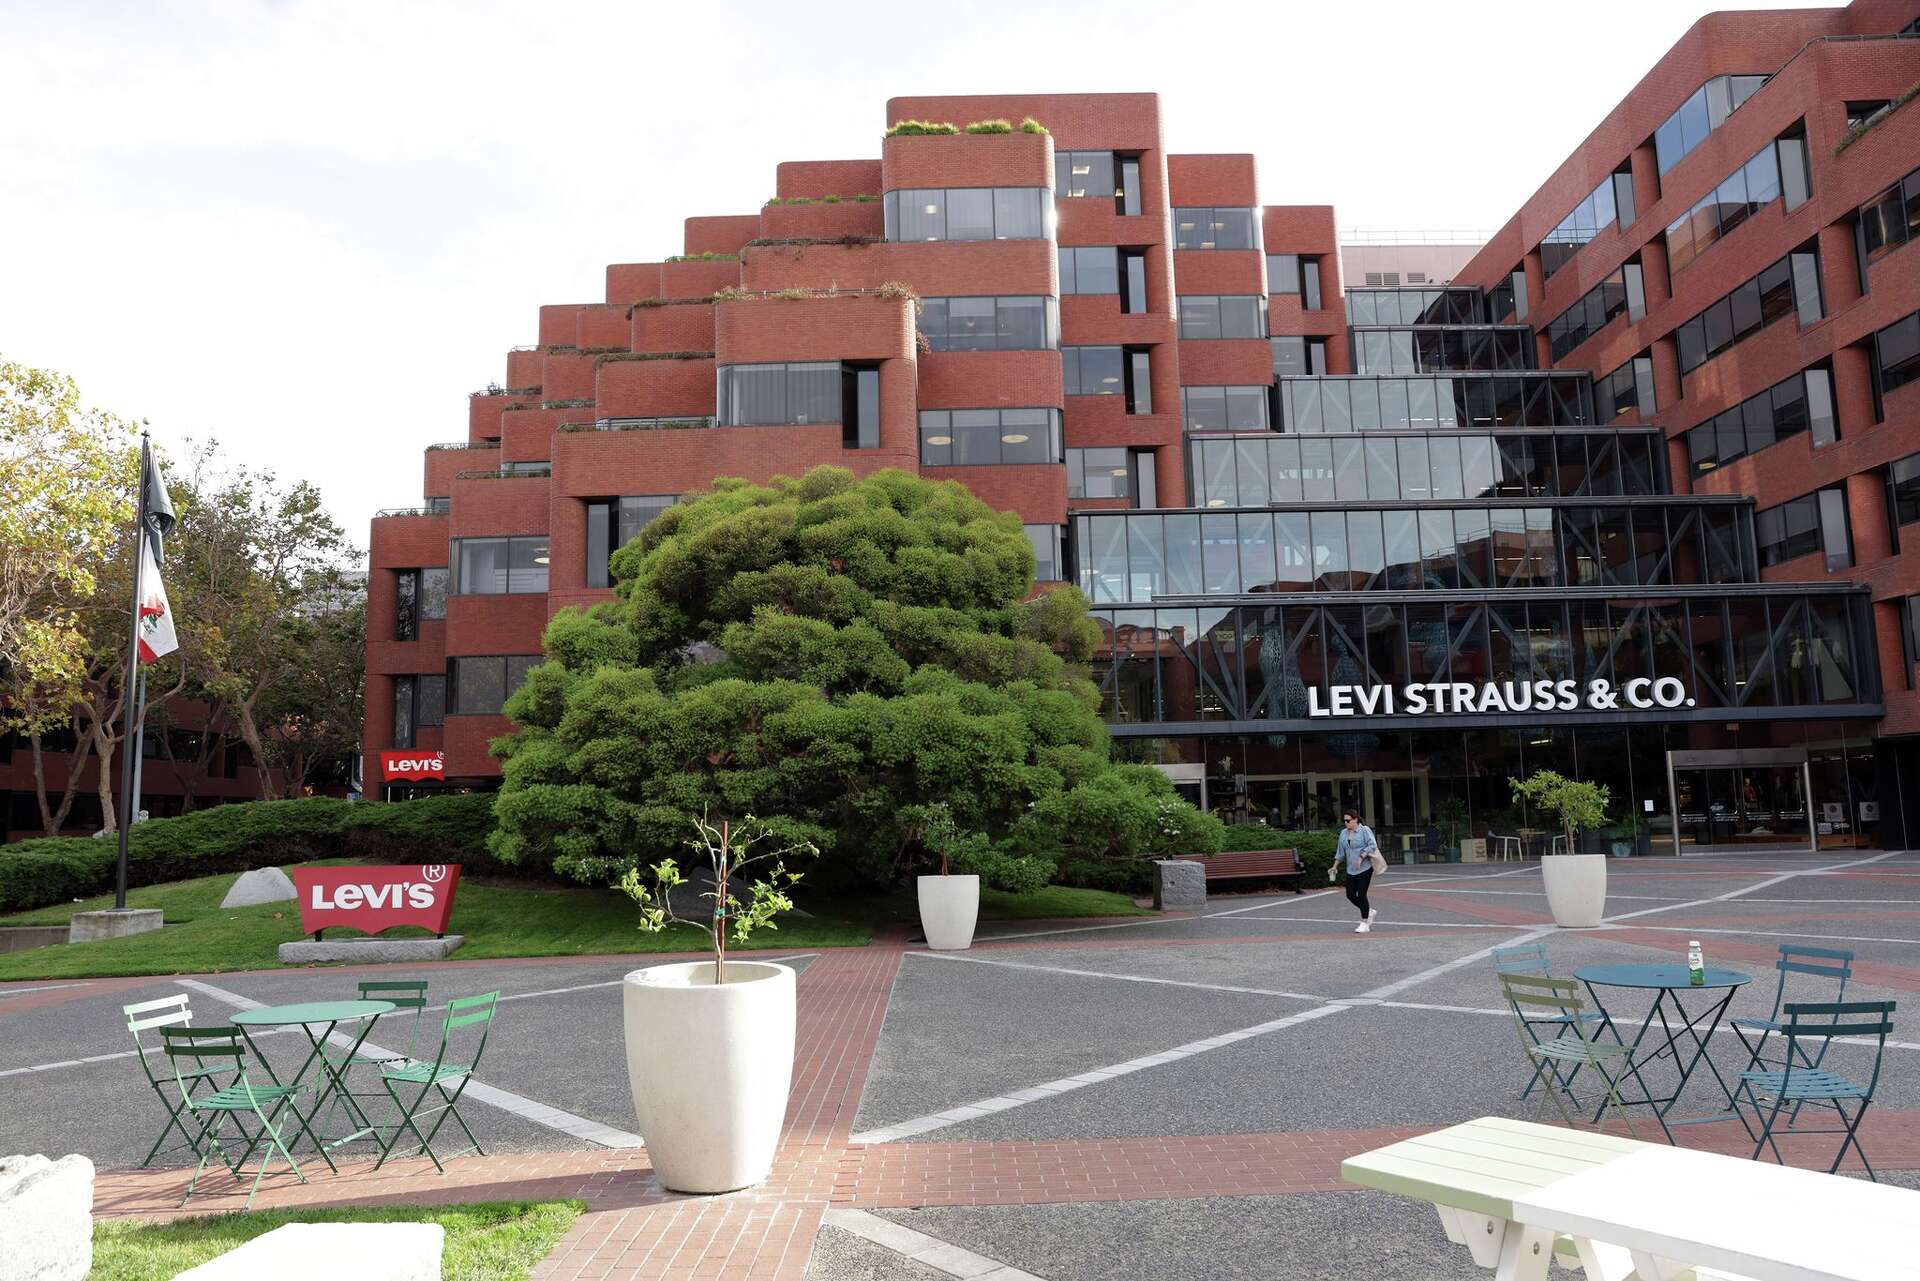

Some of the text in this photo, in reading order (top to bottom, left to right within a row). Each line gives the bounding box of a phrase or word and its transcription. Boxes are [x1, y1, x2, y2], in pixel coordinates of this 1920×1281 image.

[1308, 676, 1697, 717] LEVI STRAUSS & CO.
